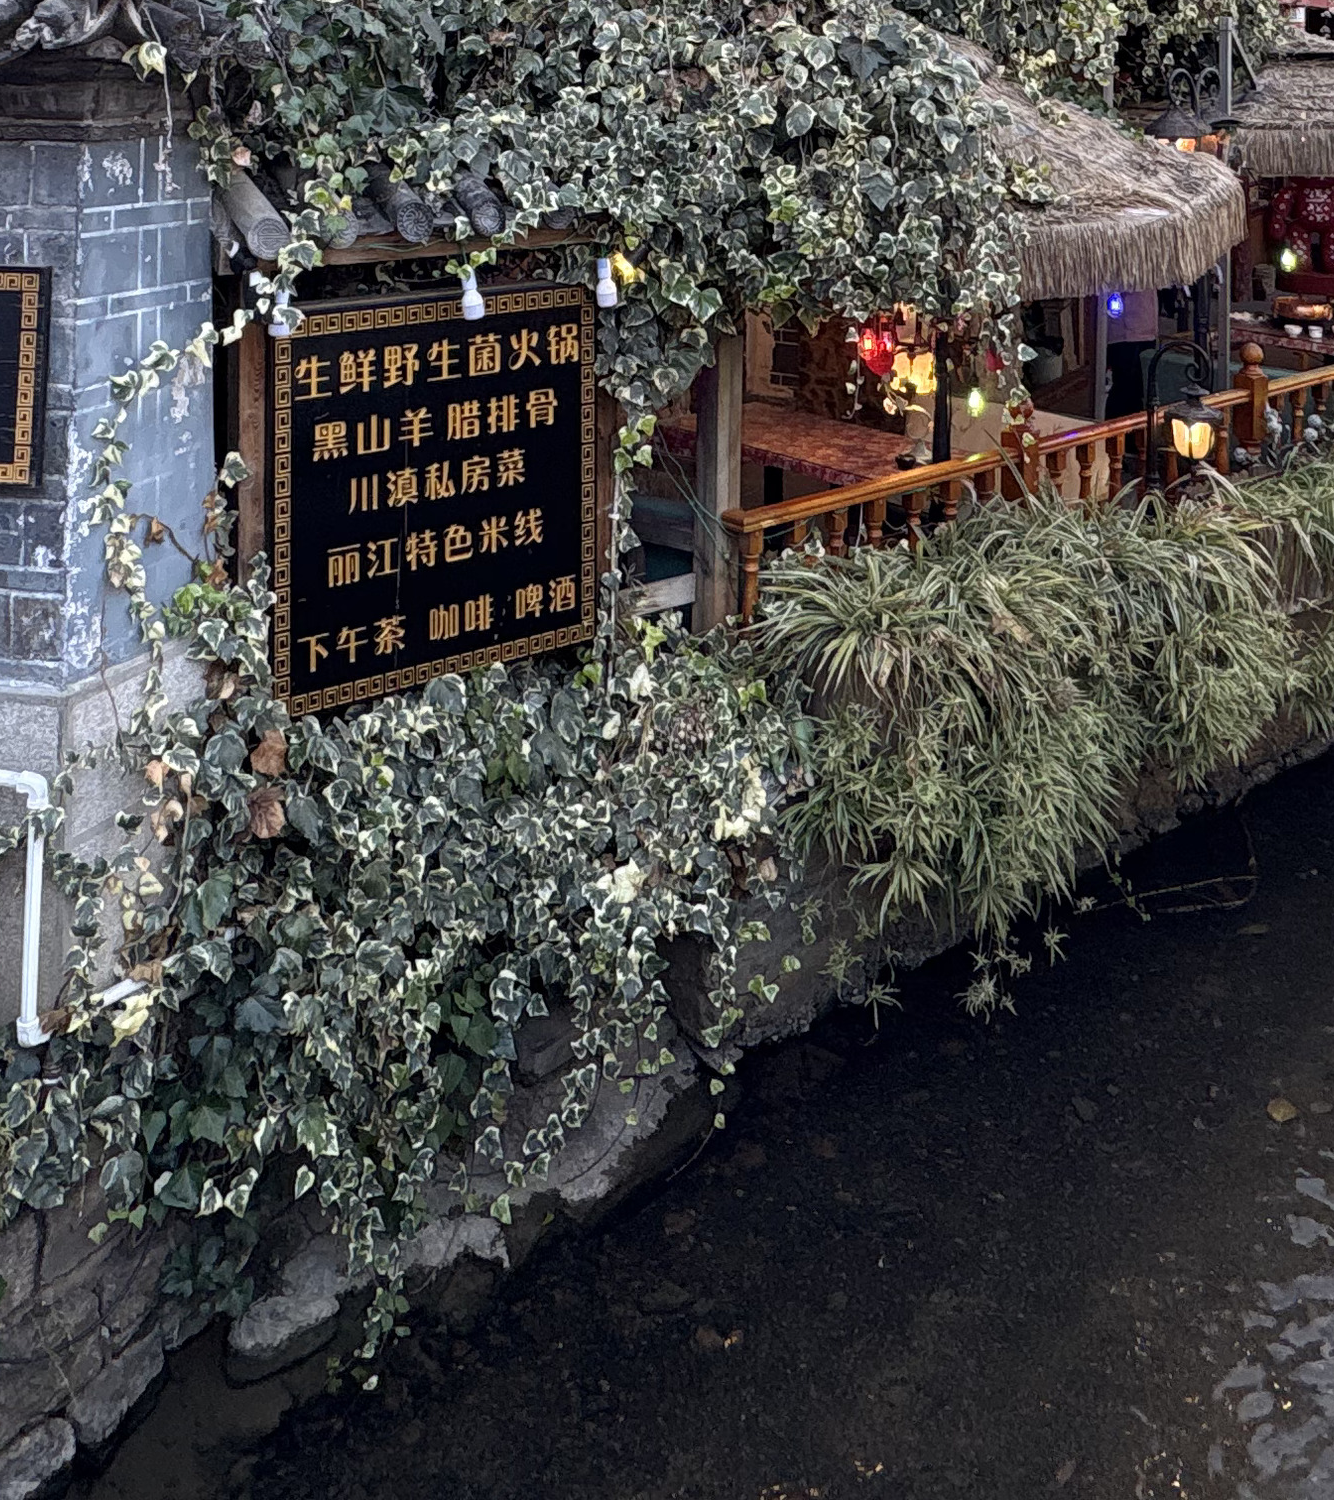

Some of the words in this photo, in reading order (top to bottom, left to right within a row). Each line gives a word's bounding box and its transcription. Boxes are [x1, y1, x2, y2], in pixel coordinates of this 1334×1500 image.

[293, 322, 581, 402] 生鲜野生菌火锅
[348, 447, 527, 515] 川滇私房菜
[326, 507, 545, 589] 丽江特色米线
[296, 614, 407, 673] 下午茶
[429, 593, 495, 641] 咖啡
[514, 573, 577, 621] 啤酒
